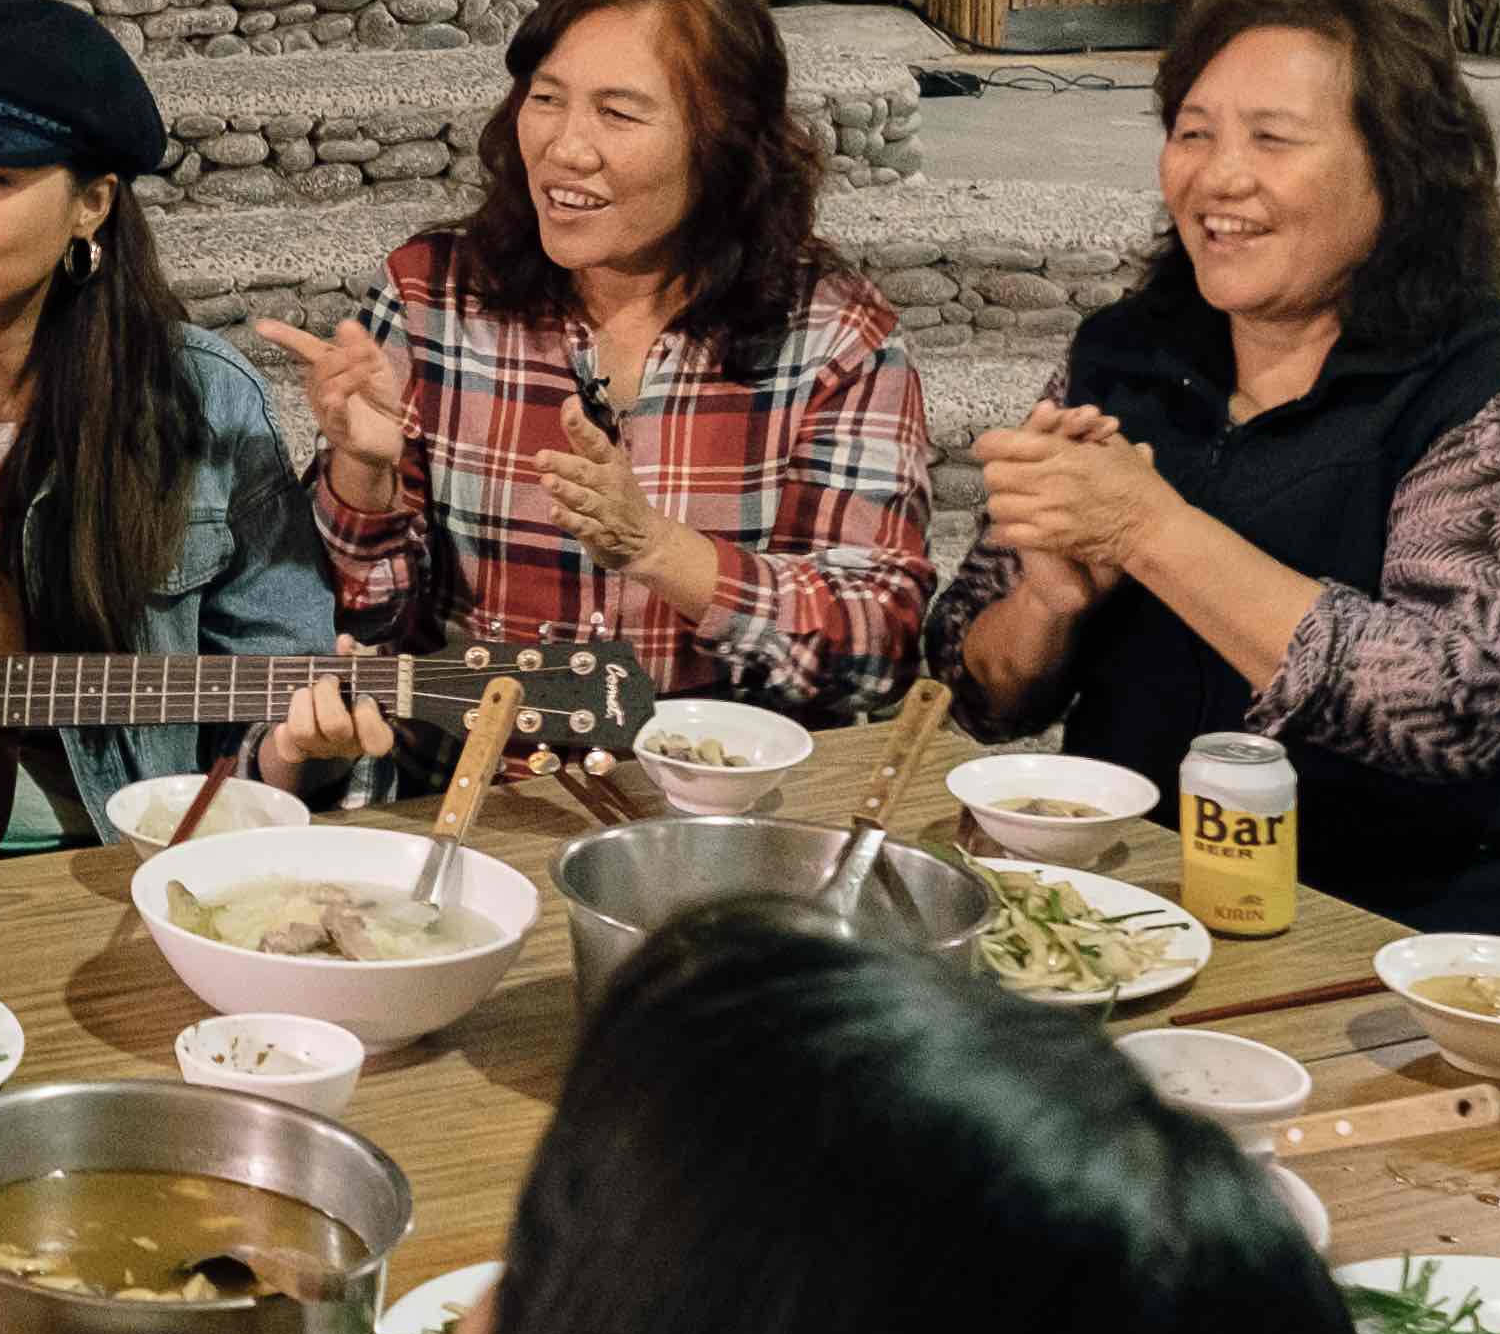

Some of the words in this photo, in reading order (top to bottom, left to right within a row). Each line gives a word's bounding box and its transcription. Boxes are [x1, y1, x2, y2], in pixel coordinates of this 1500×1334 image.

[1194, 794, 1285, 847] Bar
[1193, 840, 1254, 859] BEER
[1214, 905, 1264, 921] KIRIN
